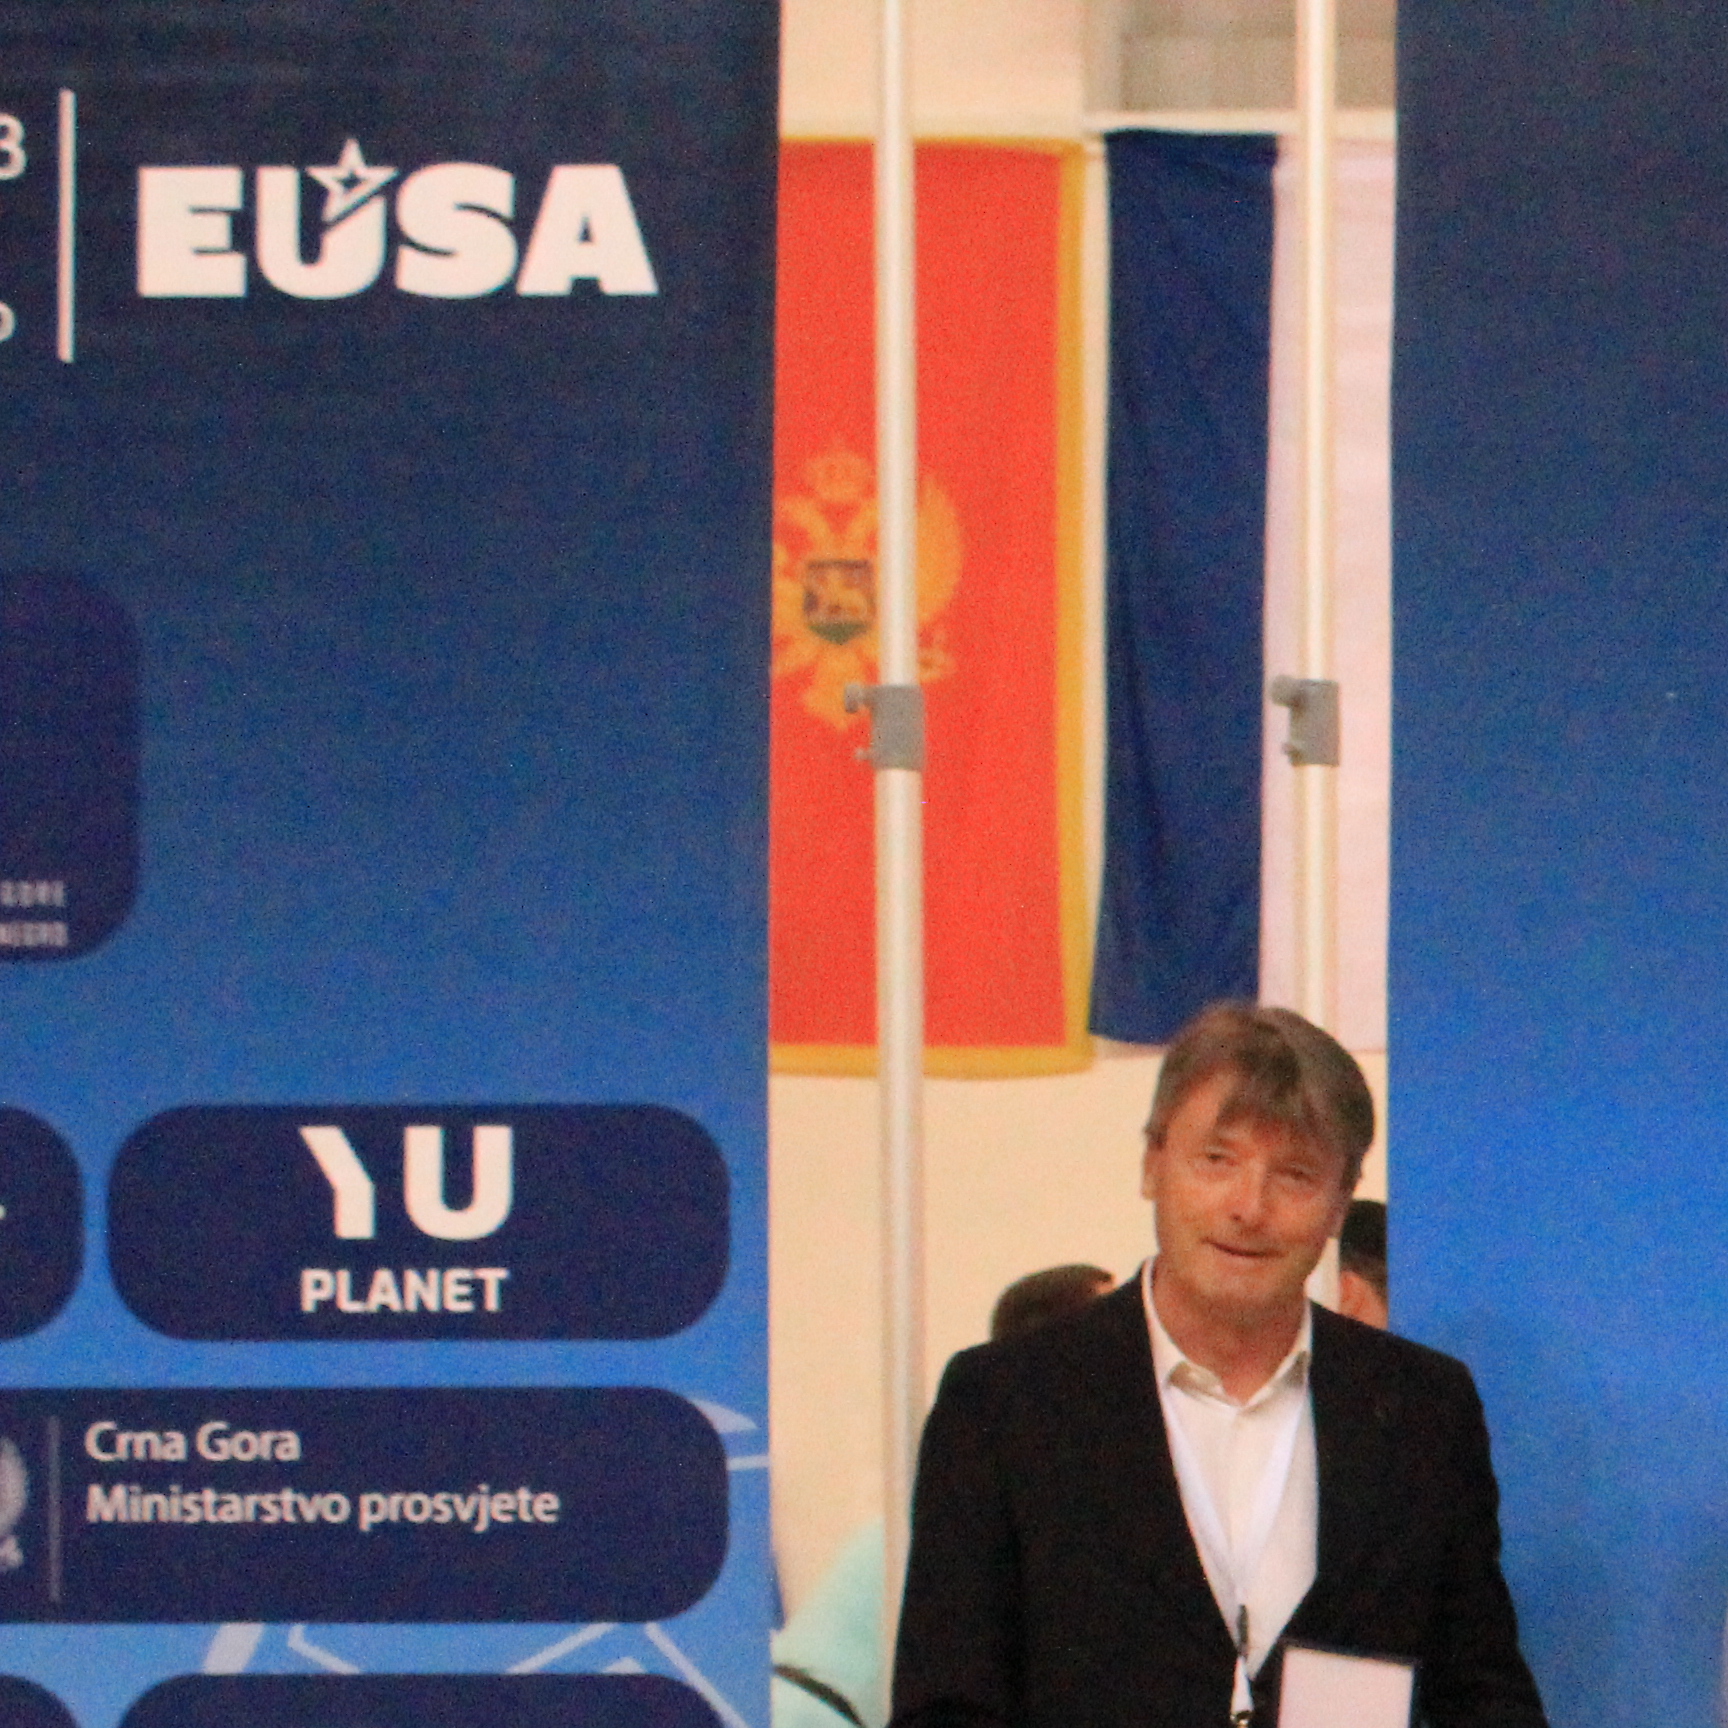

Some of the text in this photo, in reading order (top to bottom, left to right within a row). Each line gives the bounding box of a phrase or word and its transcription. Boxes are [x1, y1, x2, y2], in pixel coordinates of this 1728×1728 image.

[137, 140, 659, 299] EUSA
[299, 1125, 514, 1242] YU
[300, 1267, 510, 1314] PLANET
[84, 1421, 301, 1464] Crna Gora
[85, 1485, 561, 1535] Ministarstvo prosvjete
